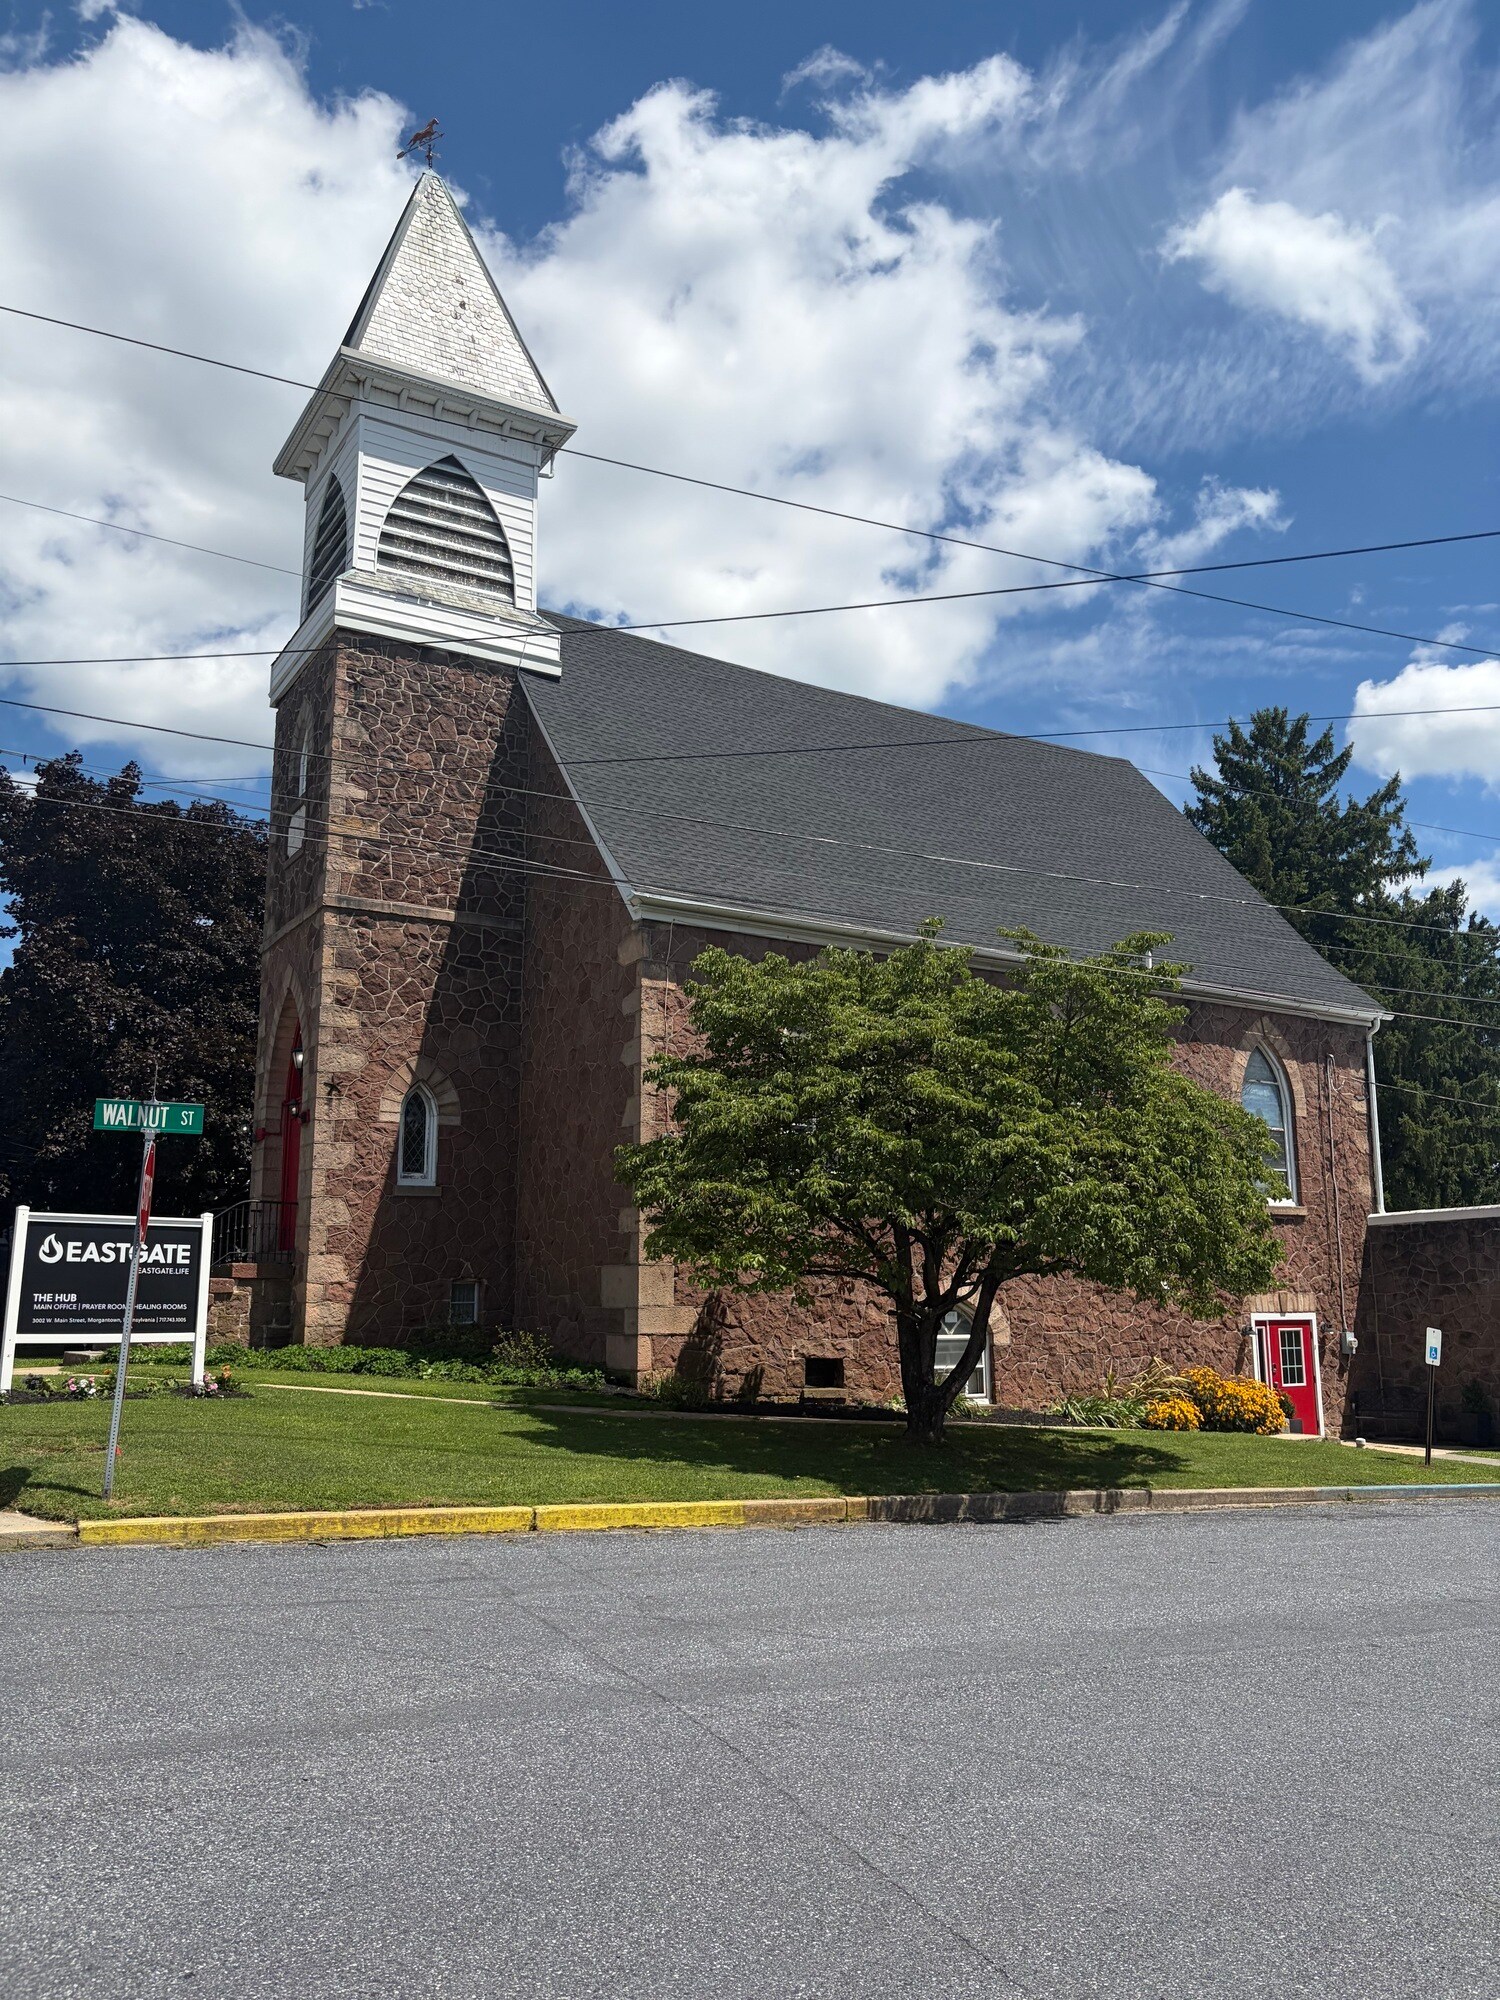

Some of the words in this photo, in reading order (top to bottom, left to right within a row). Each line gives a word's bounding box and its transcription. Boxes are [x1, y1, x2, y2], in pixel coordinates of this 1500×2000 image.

[103, 1103, 170, 1128] WALNUT
[180, 1110, 195, 1126] ST
[66, 1241, 191, 1264] EASTGATE
[33, 1293, 53, 1302] THE
[55, 1293, 77, 1302] HUB
